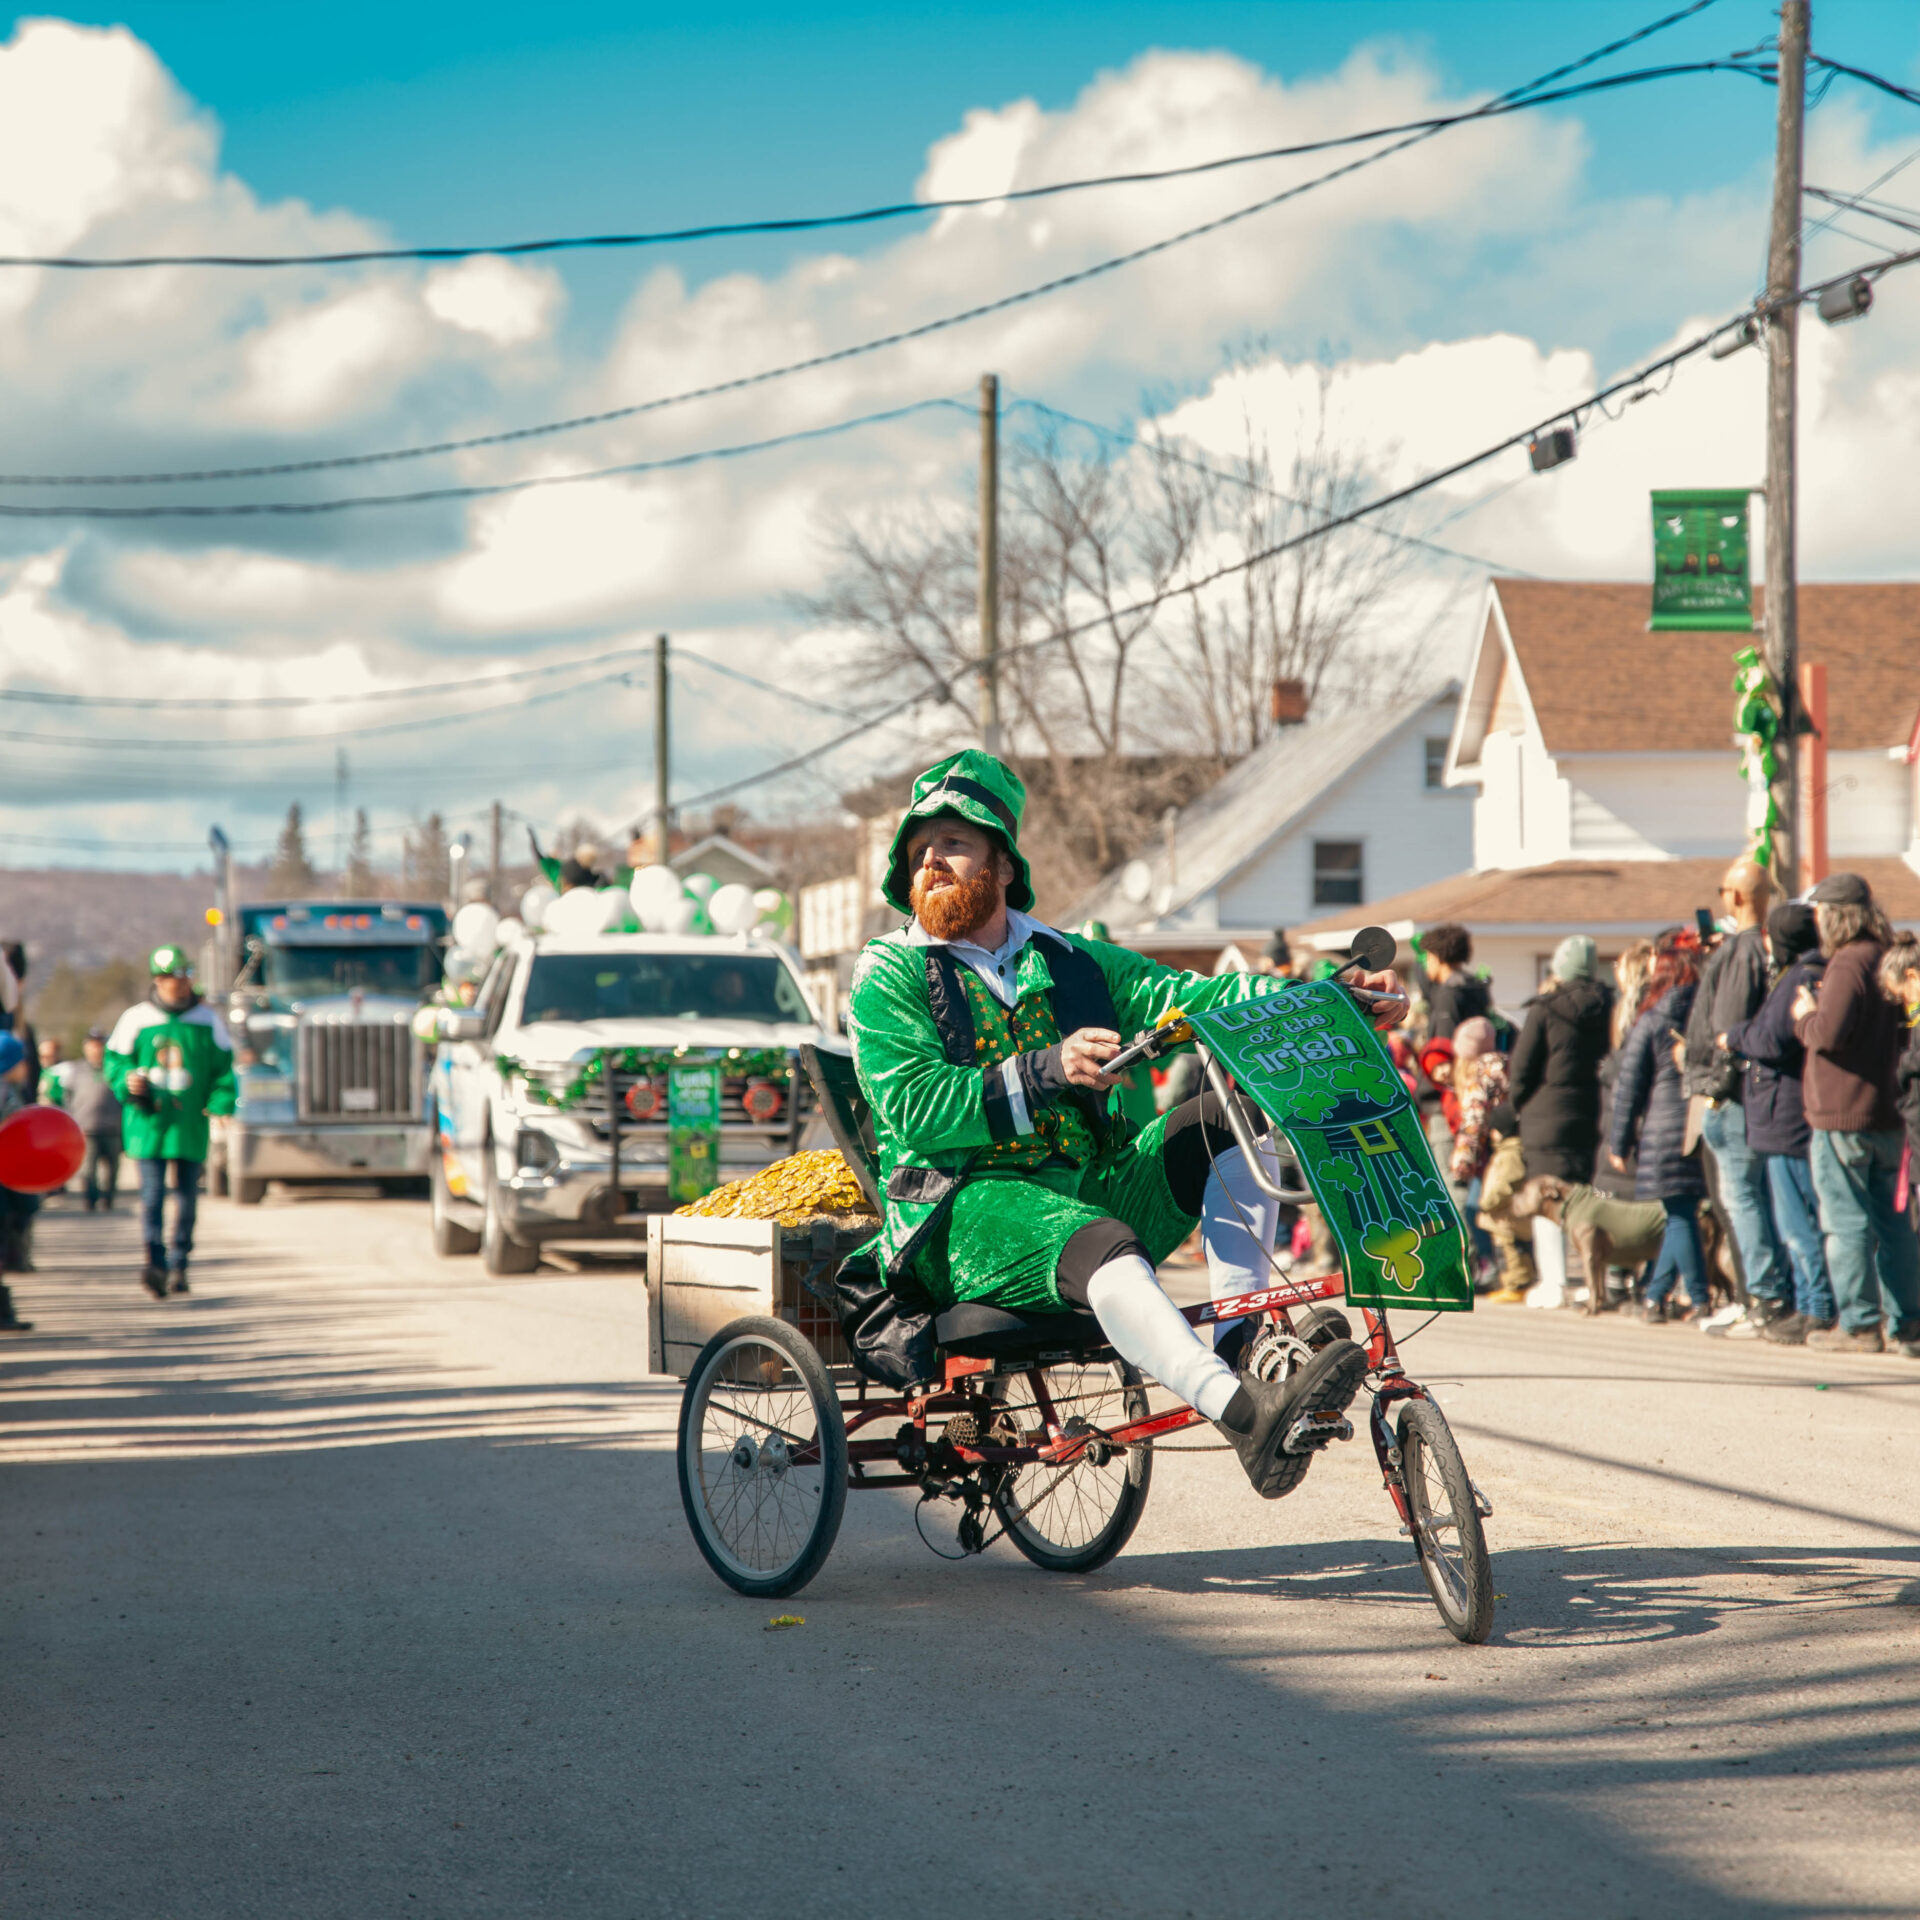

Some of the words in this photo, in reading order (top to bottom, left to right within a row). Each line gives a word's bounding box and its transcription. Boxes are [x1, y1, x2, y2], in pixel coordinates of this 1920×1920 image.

[1208, 989, 1329, 1032] Luck
[1248, 1025, 1276, 1044] of
[1281, 1013, 1326, 1033] the
[1252, 1031, 1359, 1074] Irish
